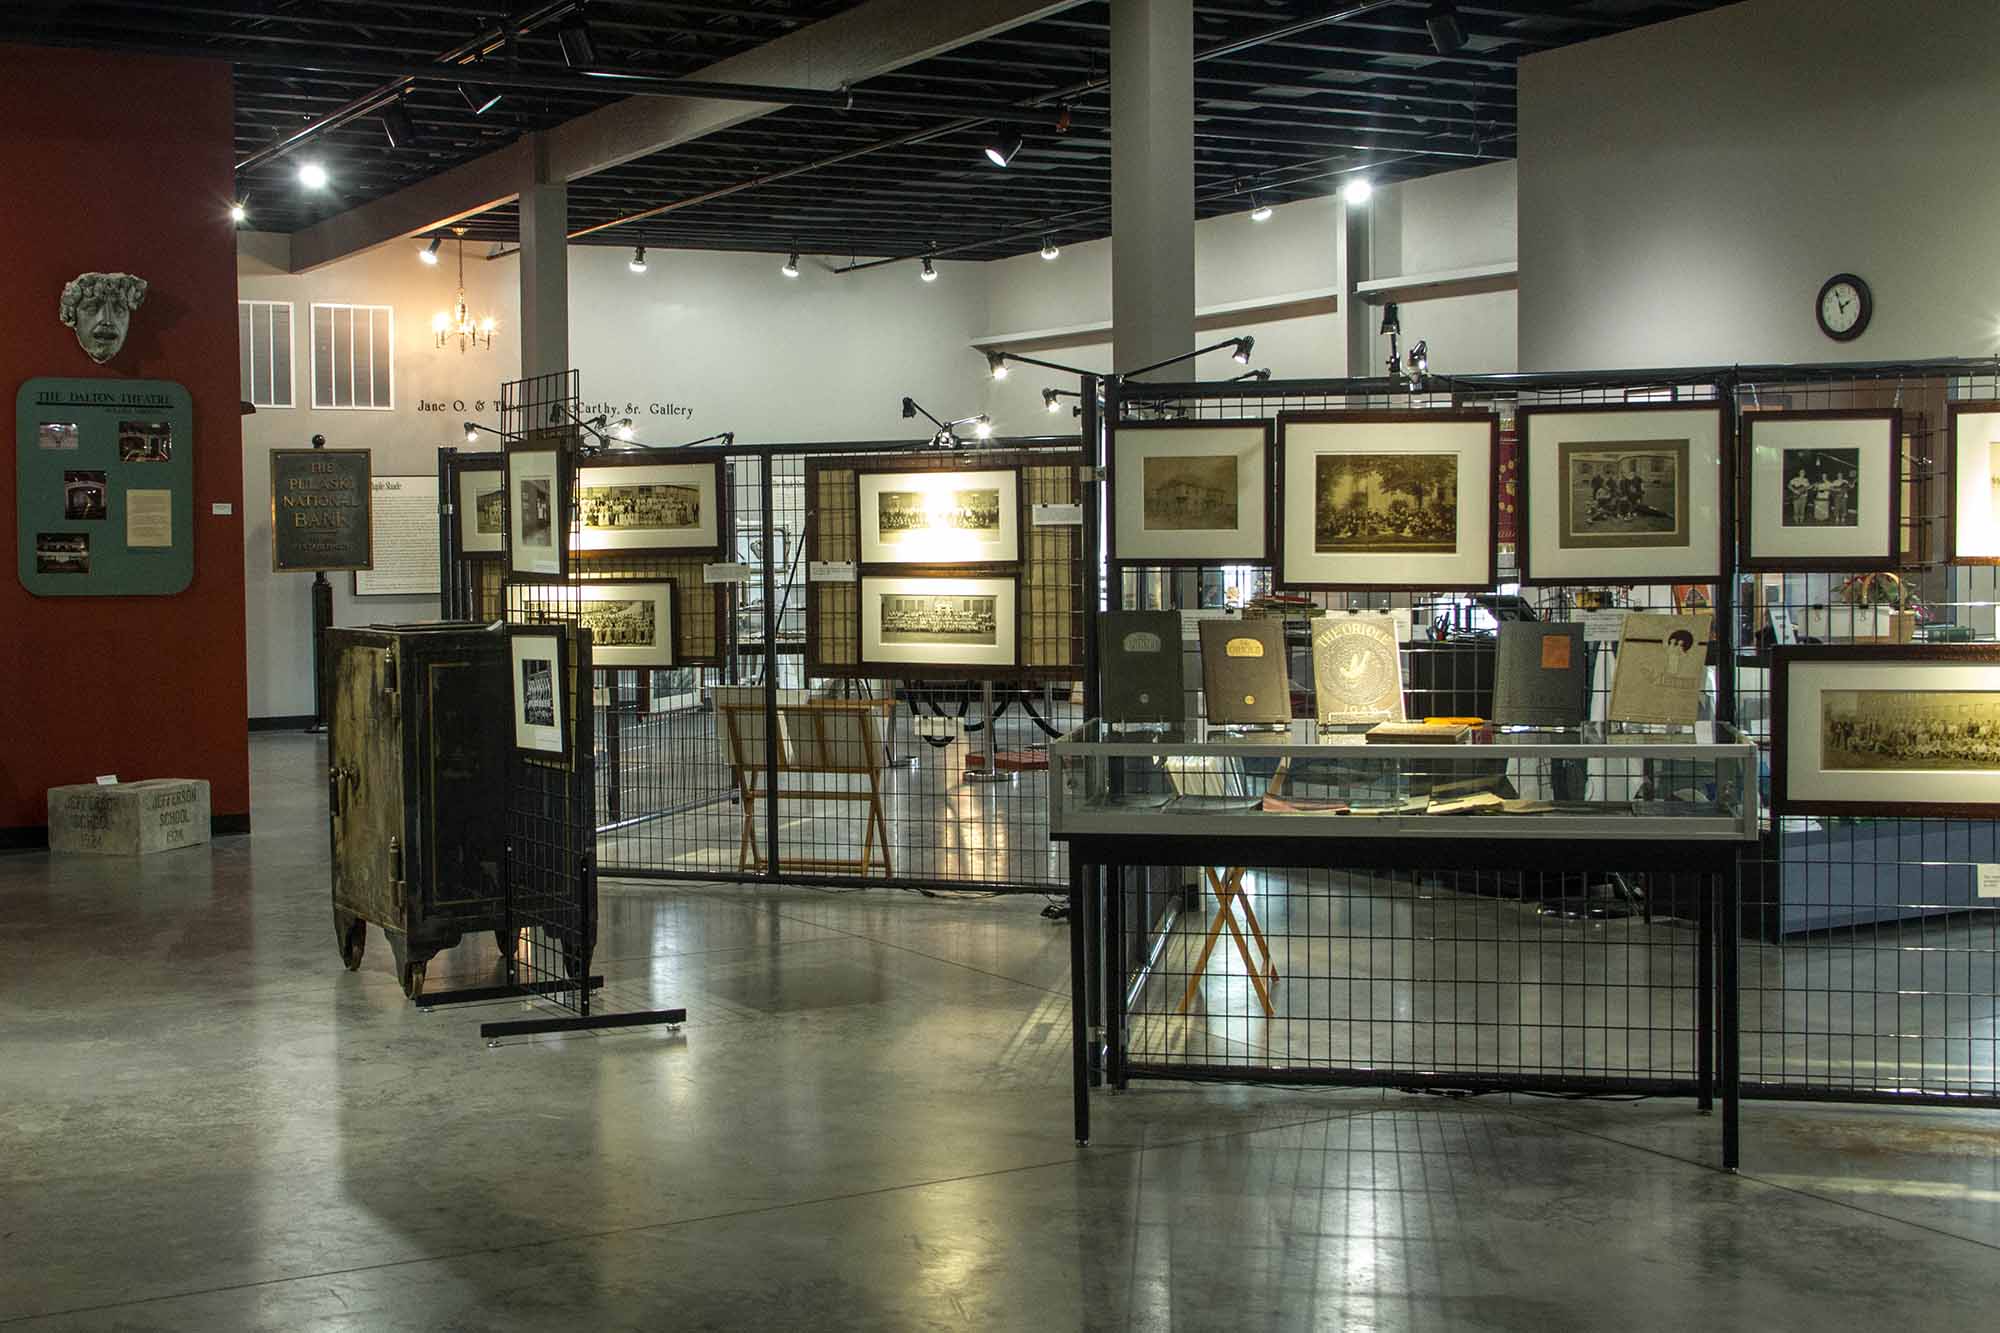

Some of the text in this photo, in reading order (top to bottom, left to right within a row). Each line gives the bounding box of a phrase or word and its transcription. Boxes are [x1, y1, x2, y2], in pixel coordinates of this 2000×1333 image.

[38, 392, 63, 402] THE
[417, 399, 446, 412] Jane
[453, 400, 467, 412] O.
[474, 400, 485, 412] &
[625, 402, 641, 414] Sr.
[649, 403, 694, 420] Gallery
[282, 495, 360, 508] NATIONAL
[294, 511, 353, 529] BANK
[1342, 623, 1391, 645] ORIOLE
[152, 785, 198, 809] JEFFERSON
[159, 808, 191, 826] SCHOOL
